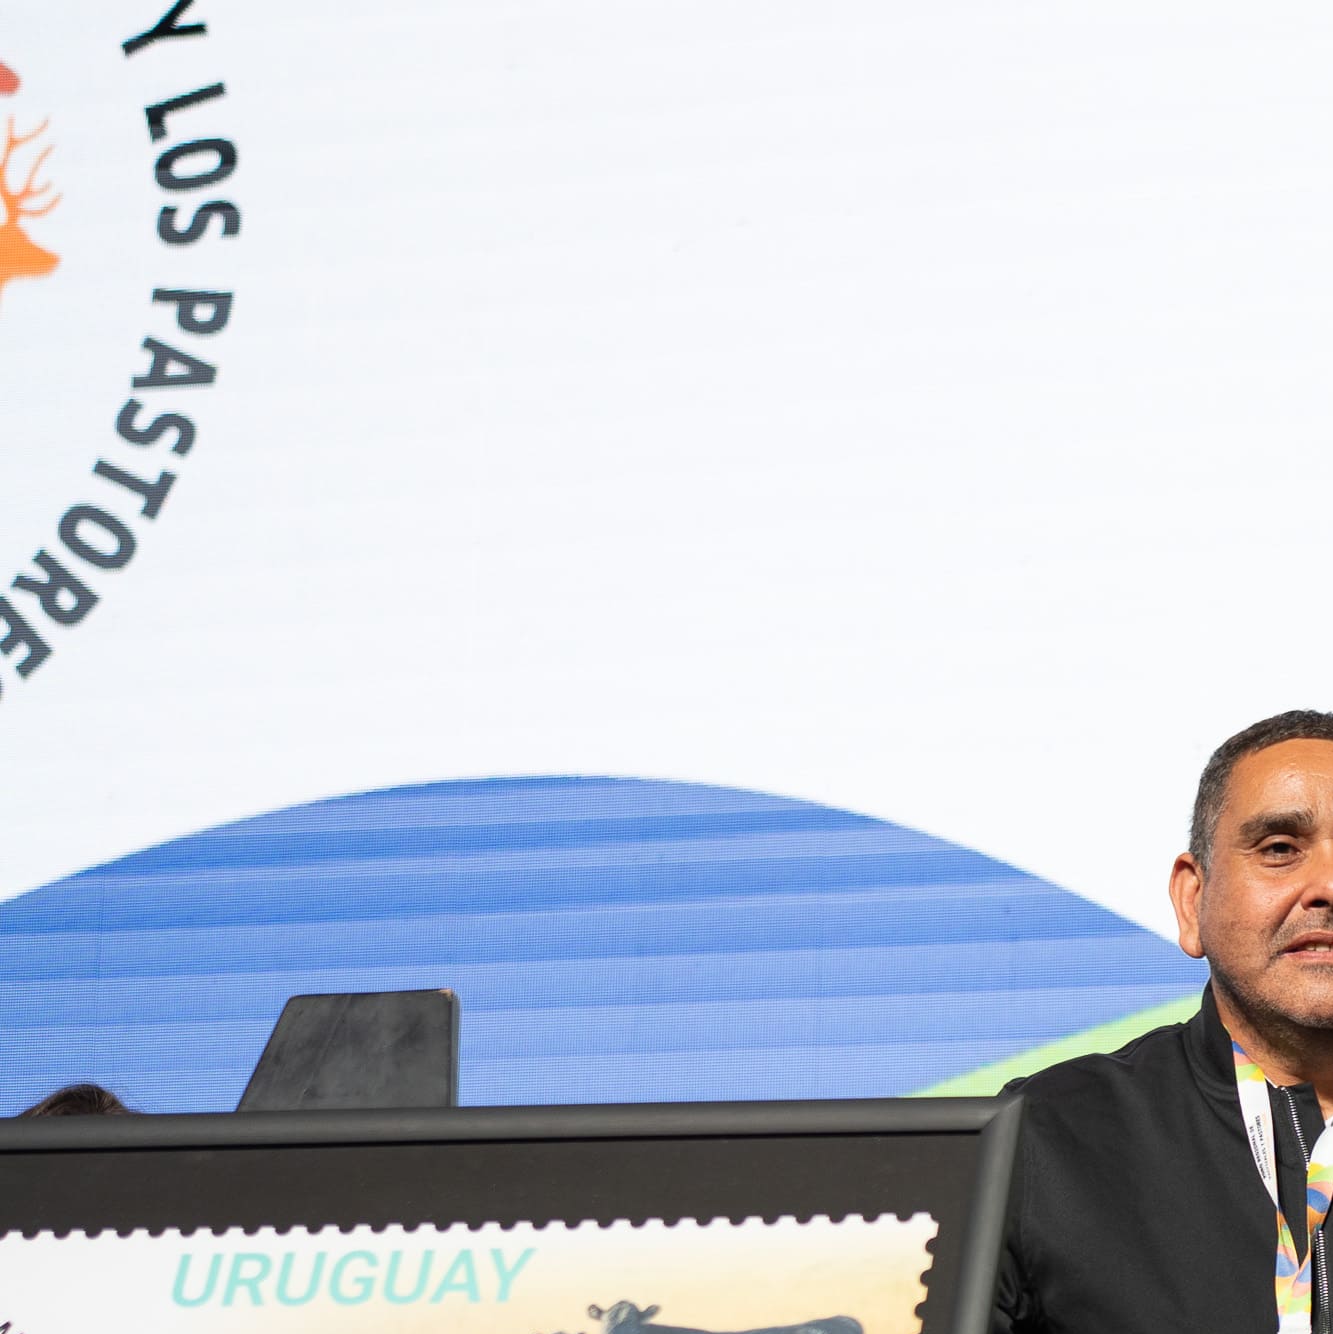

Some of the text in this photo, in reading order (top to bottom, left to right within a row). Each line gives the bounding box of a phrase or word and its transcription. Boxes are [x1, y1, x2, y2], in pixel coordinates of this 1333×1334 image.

[144, 82, 241, 246] LOS
[0, 288, 234, 696] PASTORE
[170, 1247, 536, 1309] URUGUAY
